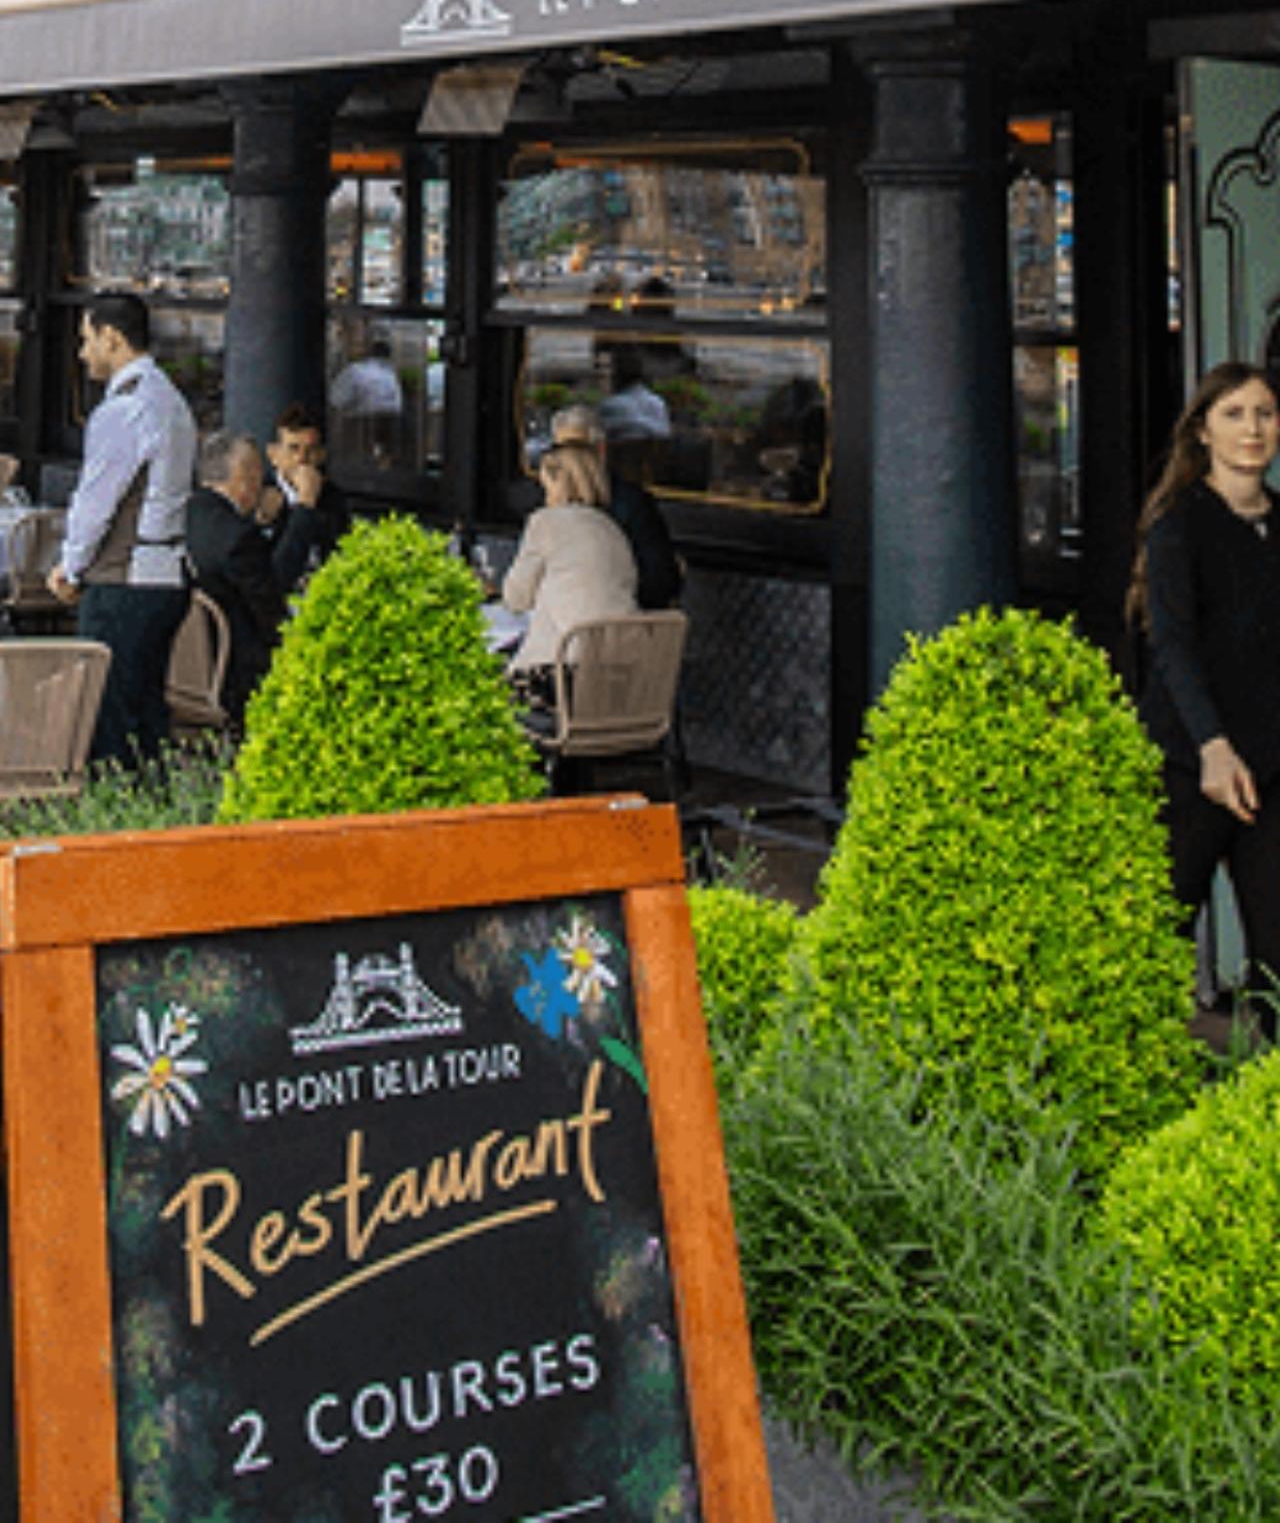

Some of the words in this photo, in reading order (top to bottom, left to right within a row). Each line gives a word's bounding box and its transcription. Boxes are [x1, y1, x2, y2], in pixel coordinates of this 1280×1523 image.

[239, 1081, 271, 1120] LE
[275, 1065, 363, 1115] PONT
[372, 1059, 402, 1101] DE
[405, 1053, 440, 1095] LA
[442, 1042, 520, 1089] TOUR
[160, 1058, 612, 1326] Restaurant
[228, 1408, 273, 1475] 2
[305, 1333, 601, 1455] COURSES
[372, 1445, 499, 1523] £30
